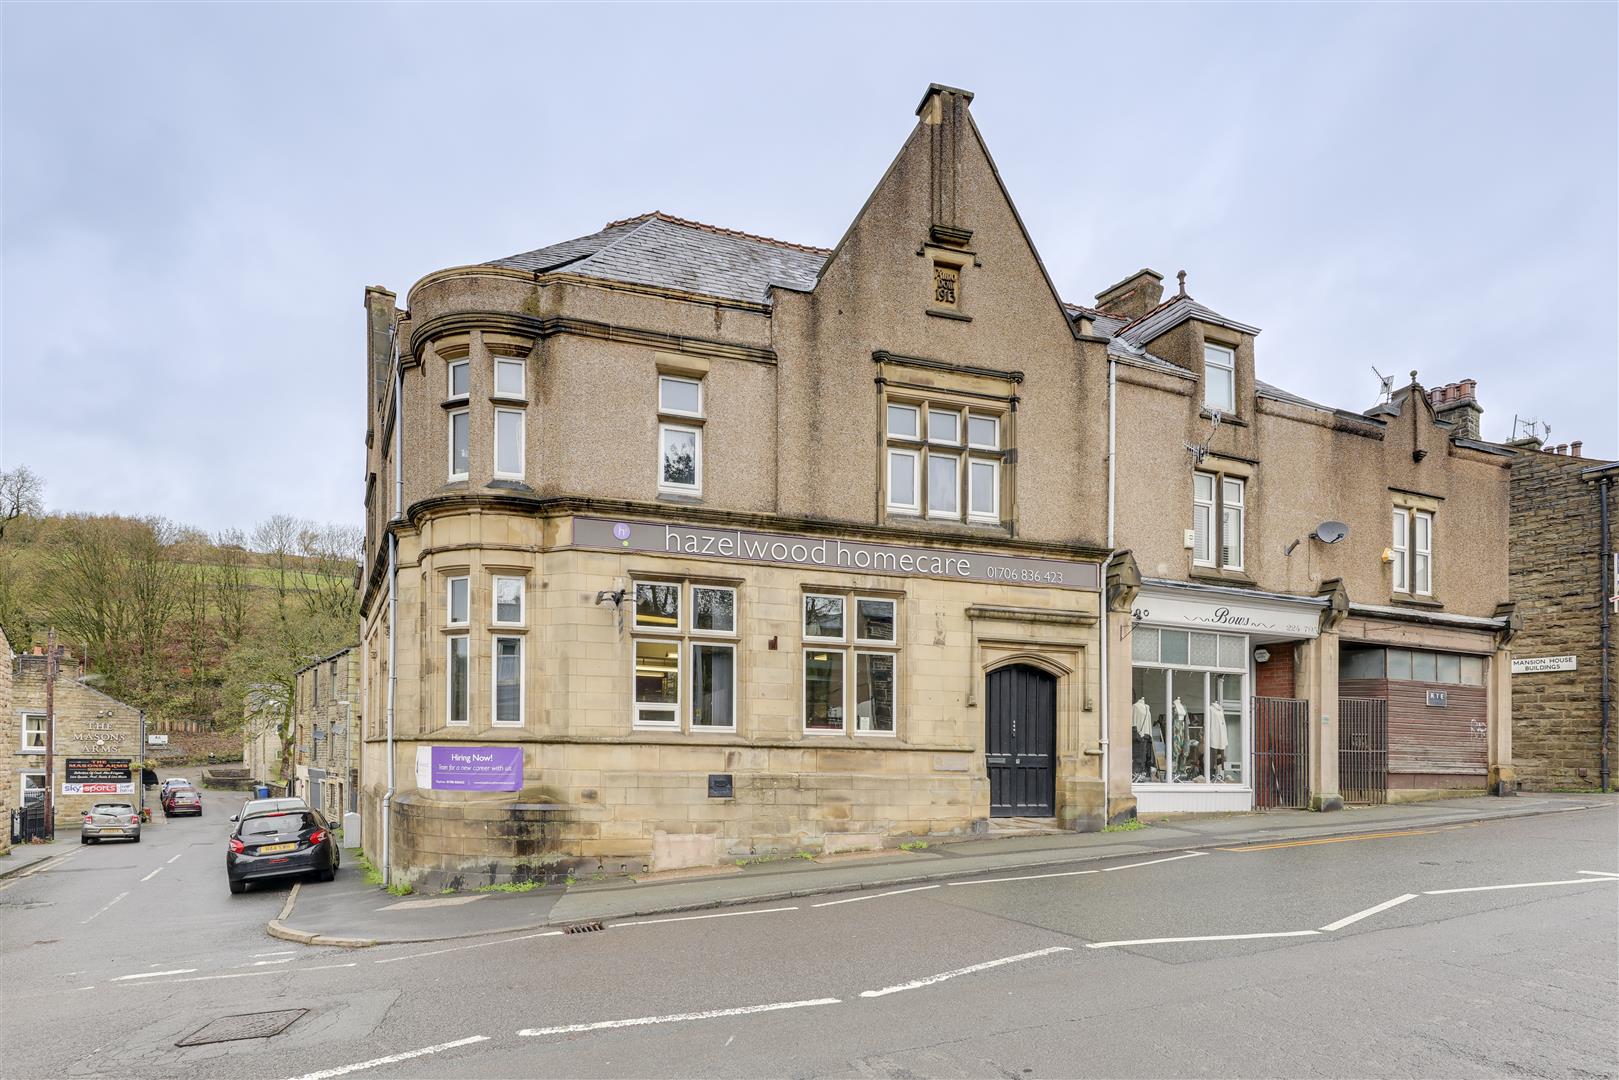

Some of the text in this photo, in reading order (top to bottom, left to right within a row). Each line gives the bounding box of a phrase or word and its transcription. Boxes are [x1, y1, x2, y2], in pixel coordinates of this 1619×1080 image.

[935, 289, 955, 304] 1913
[665, 525, 970, 576] hazelwood homecare
[987, 566, 1063, 584] 01706 836 423
[1211, 607, 1249, 625] Bows
[1513, 656, 1573, 667] MANSION HOUSE
[88, 722, 113, 730] THE
[82, 745, 118, 753] ARMS
[451, 753, 493, 763] Hiring Now!
[64, 784, 81, 793] sky
[83, 784, 116, 793] sports
